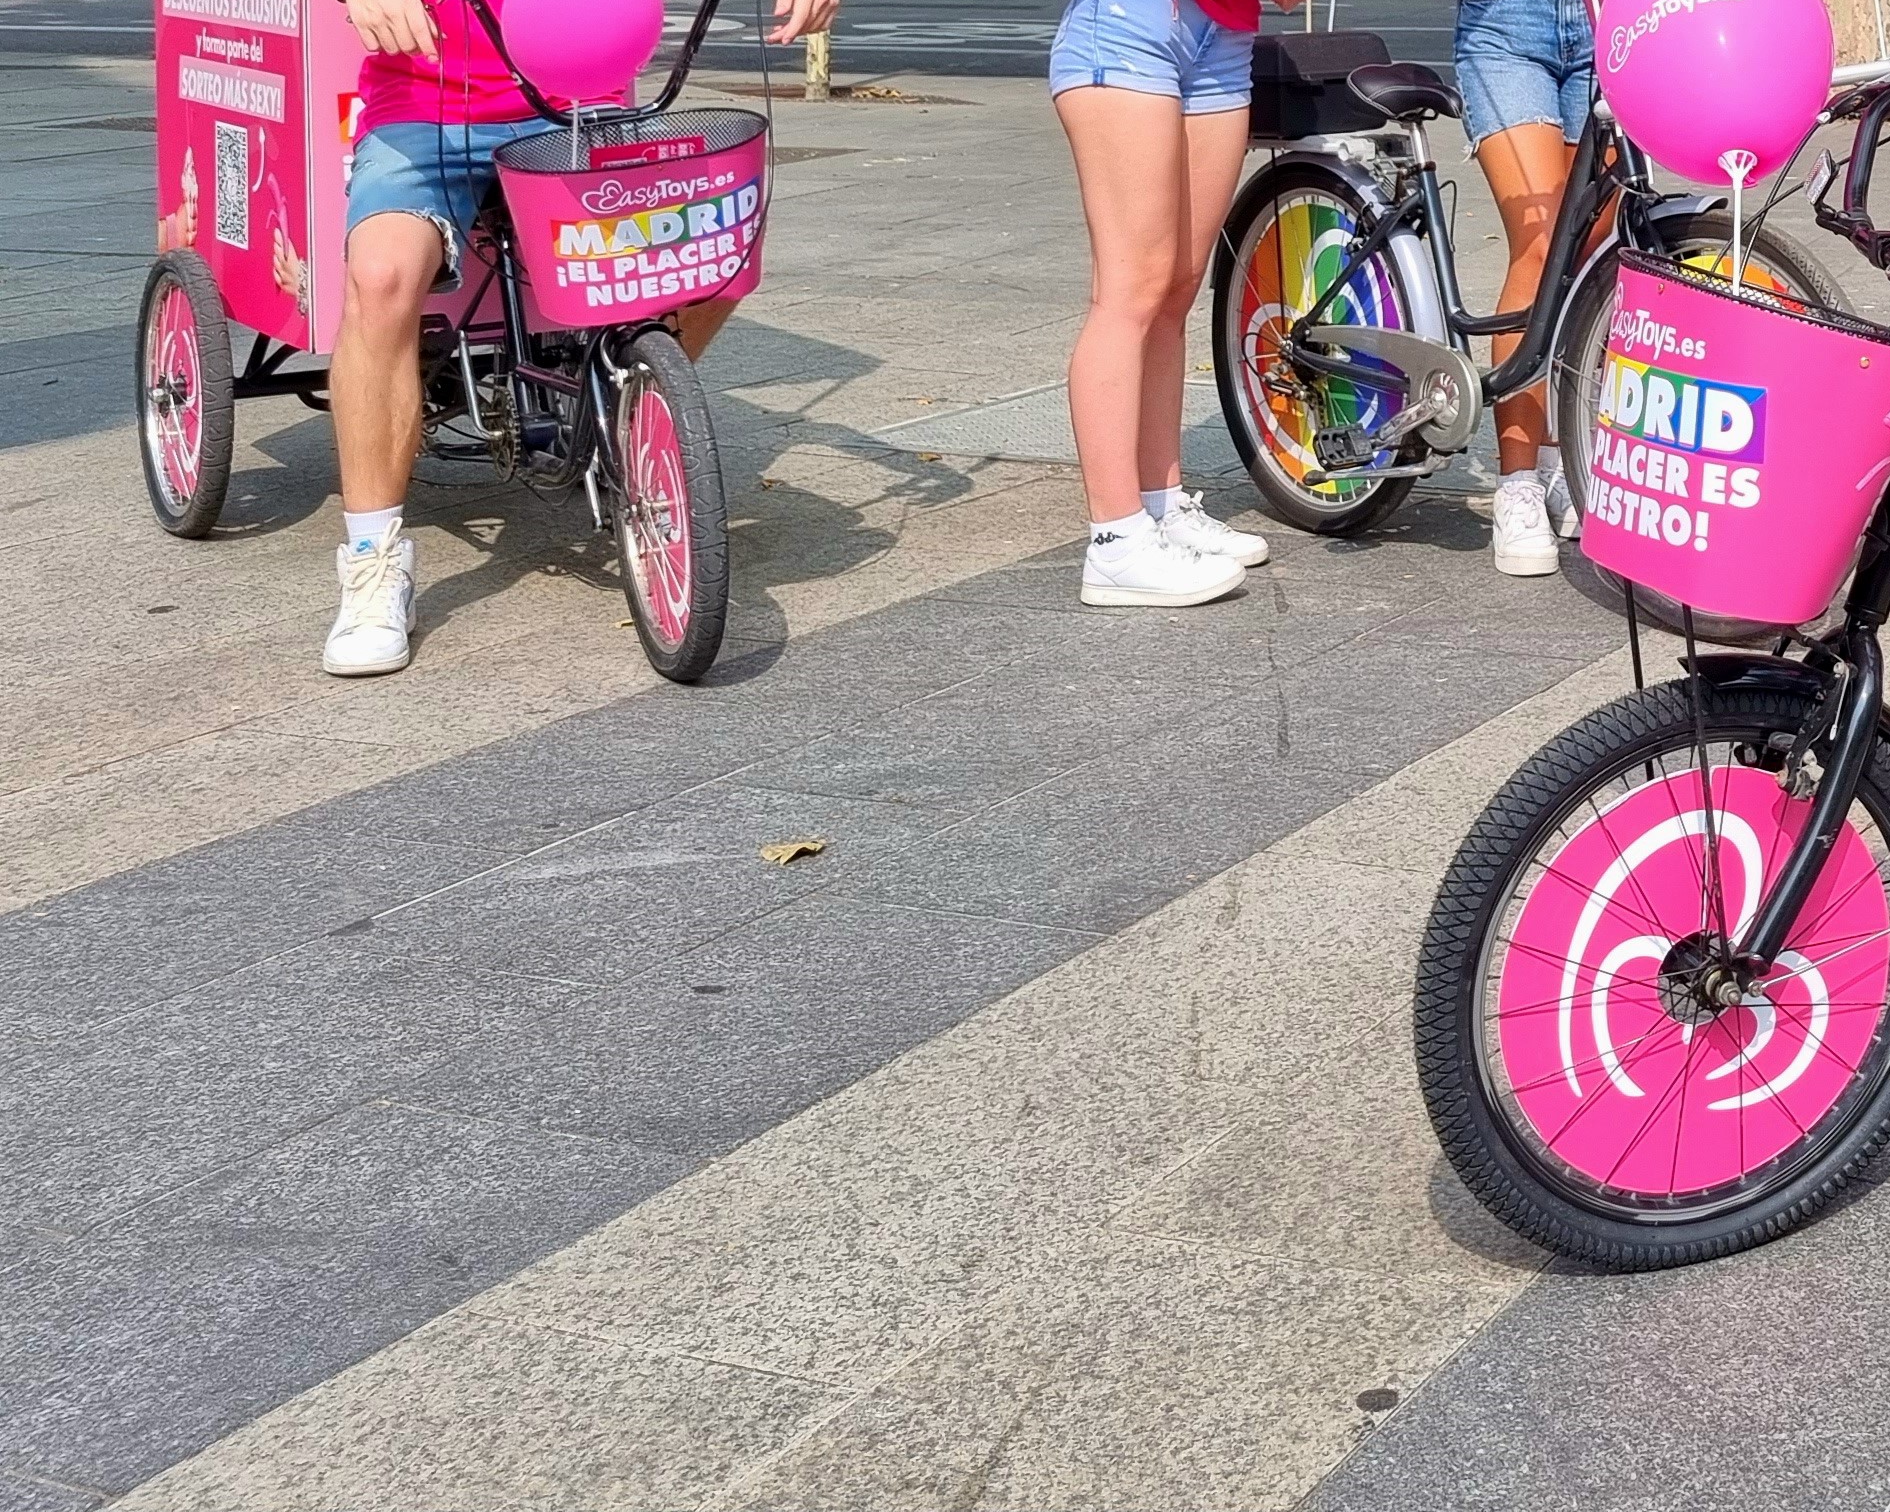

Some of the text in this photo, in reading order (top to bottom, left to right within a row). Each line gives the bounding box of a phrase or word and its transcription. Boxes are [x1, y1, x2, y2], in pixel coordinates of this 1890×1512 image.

[195, 27, 264, 65] y forma parte del
[181, 67, 282, 119] SORTEO MÁS SEXY!
[581, 171, 735, 214] EasyToys.es
[559, 183, 759, 257] MADRID
[557, 260, 606, 288] ¡EL
[613, 232, 738, 279] PLACER
[1702, 463, 1761, 509] ES
